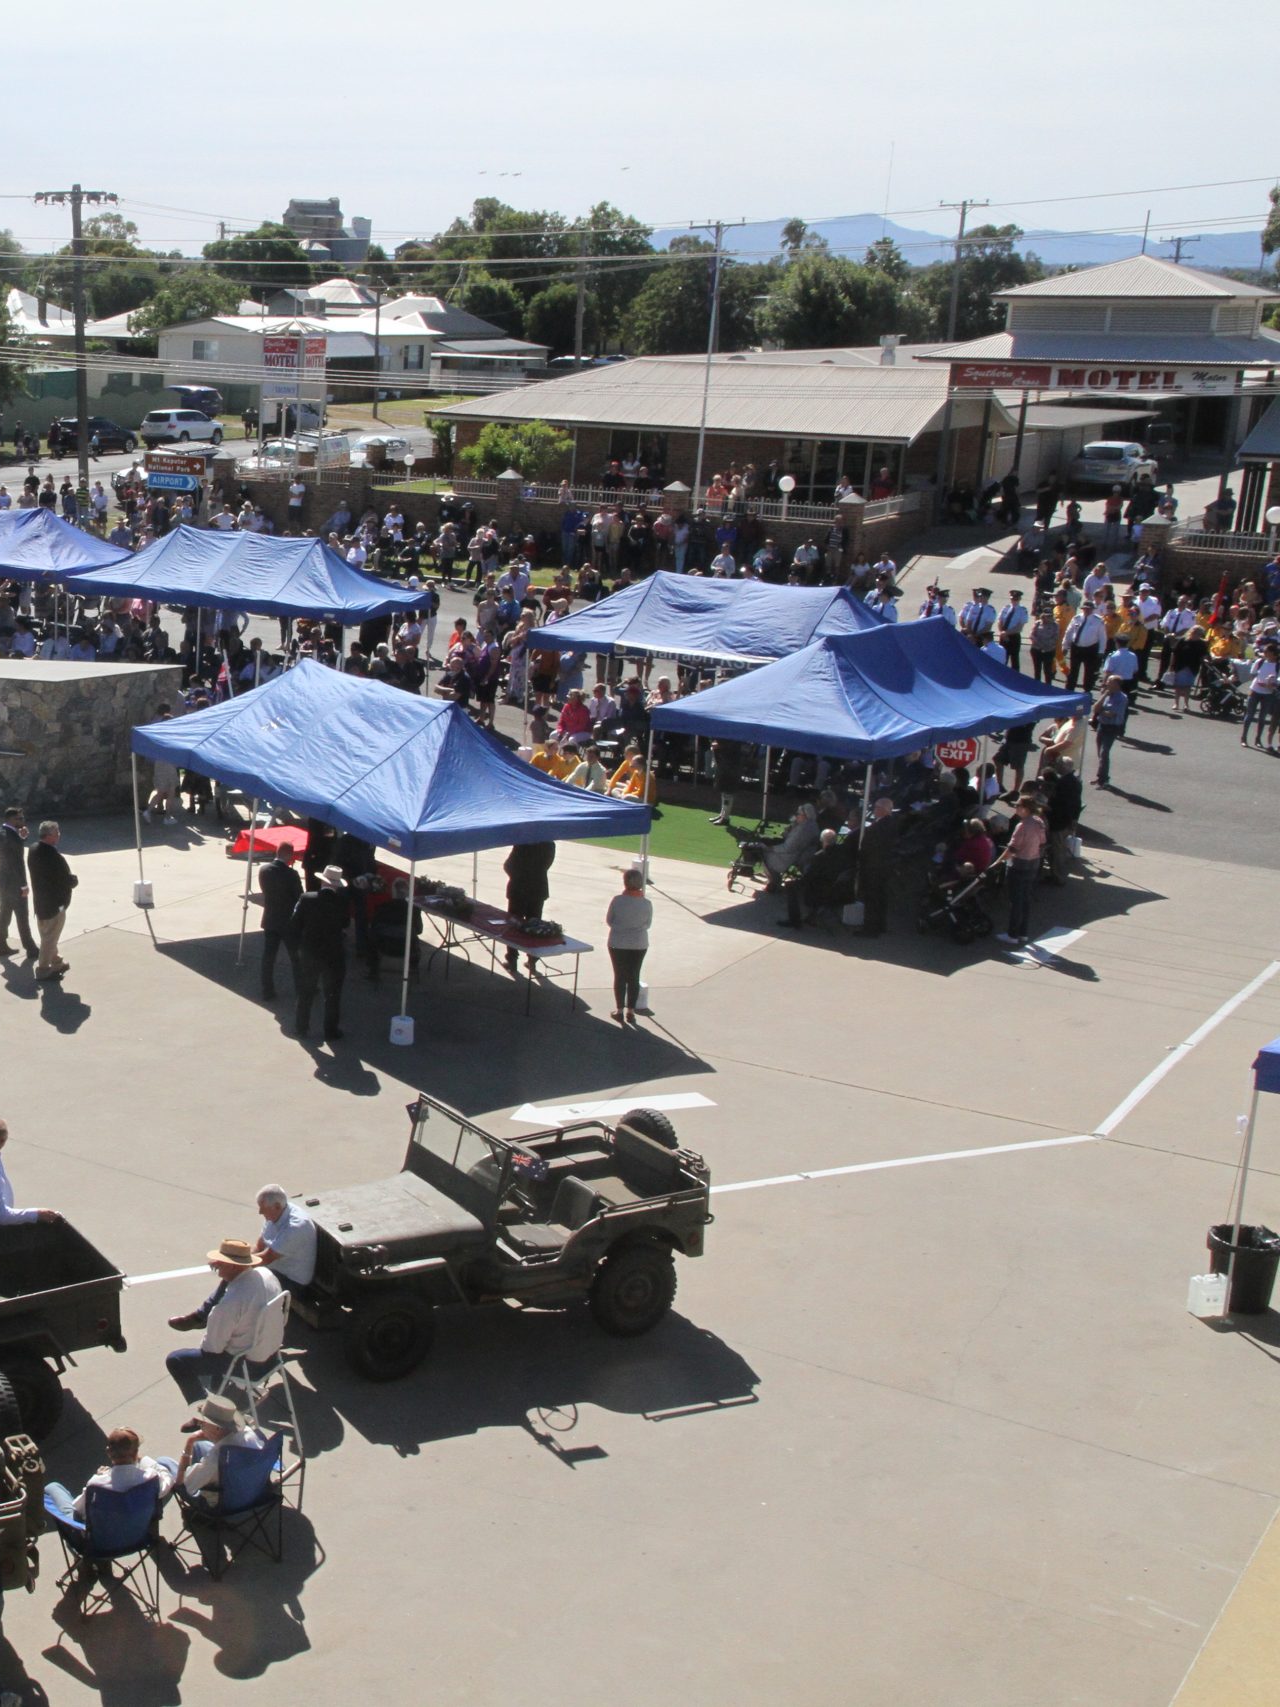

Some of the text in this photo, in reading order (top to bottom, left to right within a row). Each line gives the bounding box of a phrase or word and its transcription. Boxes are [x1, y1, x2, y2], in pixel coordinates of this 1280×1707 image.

[264, 354, 297, 367] MOTEL
[963, 367, 1014, 378] Southern
[1012, 377, 1040, 387] Cross
[1057, 369, 1183, 391] MOTEL
[152, 475, 183, 486] AIRPORT
[947, 739, 968, 750] NO
[940, 747, 973, 761] EXIT
